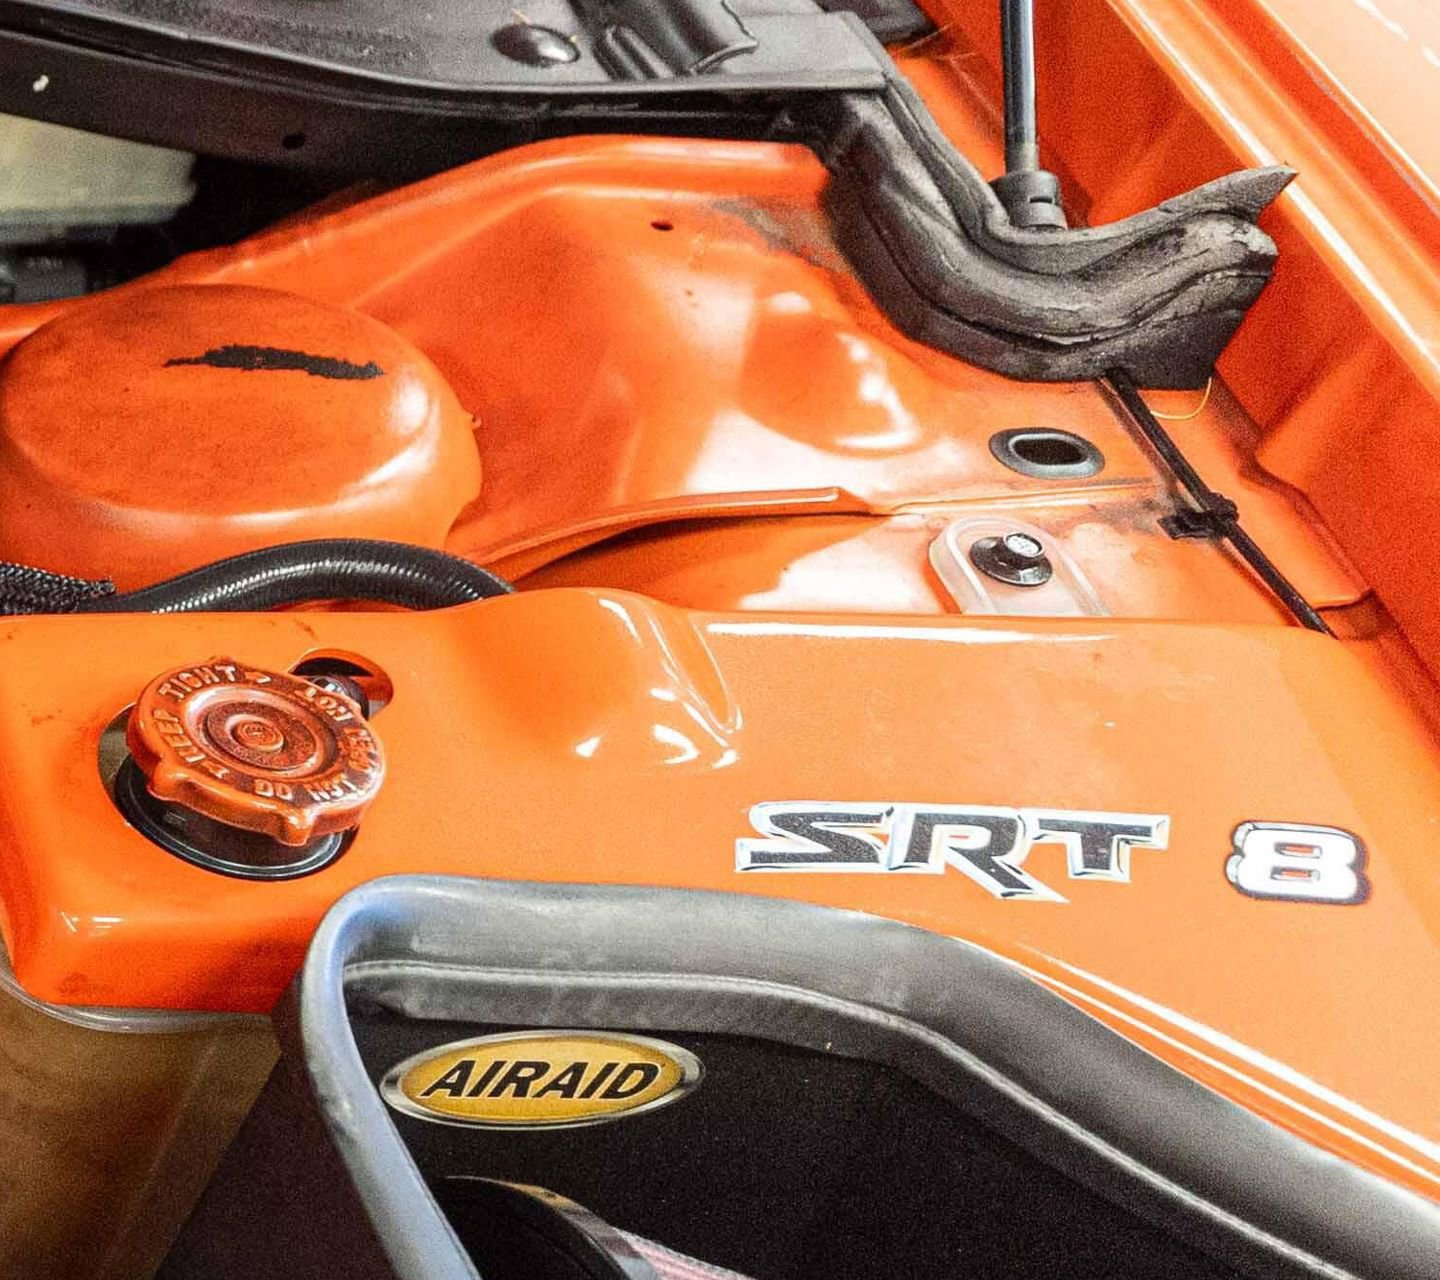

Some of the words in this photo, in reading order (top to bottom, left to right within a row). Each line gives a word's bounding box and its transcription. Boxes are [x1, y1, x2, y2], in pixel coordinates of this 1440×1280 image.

[158, 664, 237, 701] TIGHT
[253, 778, 294, 800] DO
[735, 801, 1171, 904] SRT
[1225, 820, 1373, 906] 8
[419, 1058, 664, 1102] AIRAID
